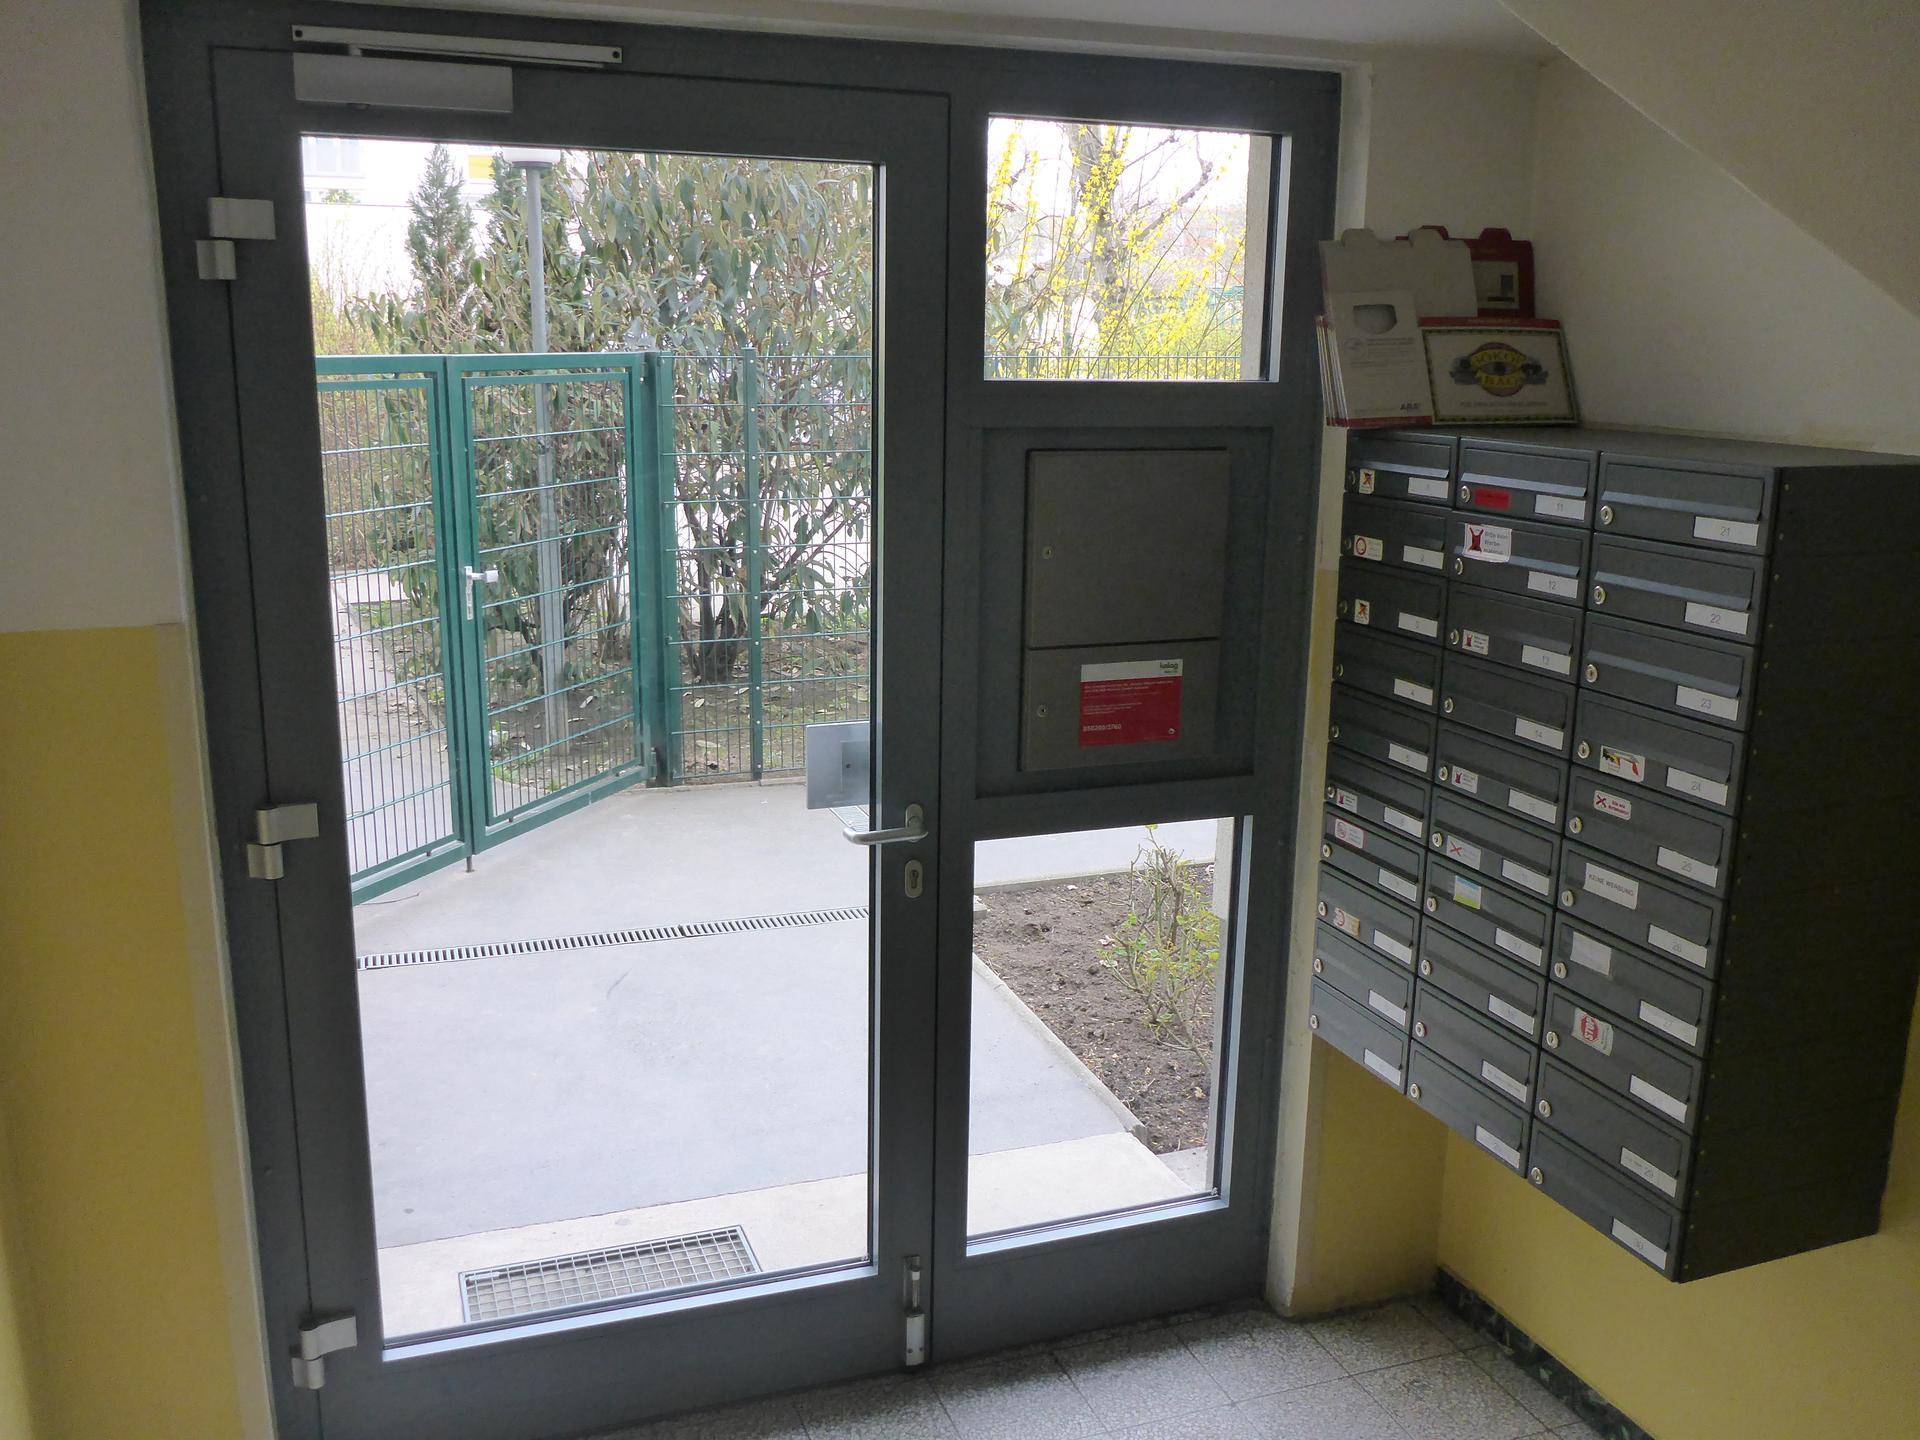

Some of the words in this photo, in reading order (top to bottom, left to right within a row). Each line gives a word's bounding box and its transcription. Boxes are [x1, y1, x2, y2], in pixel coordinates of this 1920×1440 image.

[1555, 502, 1565, 512] 11
[1719, 525, 1731, 537] 21
[1548, 580, 1557, 590] 12
[1709, 613, 1721, 625] 22
[1699, 697, 1712, 709] 23
